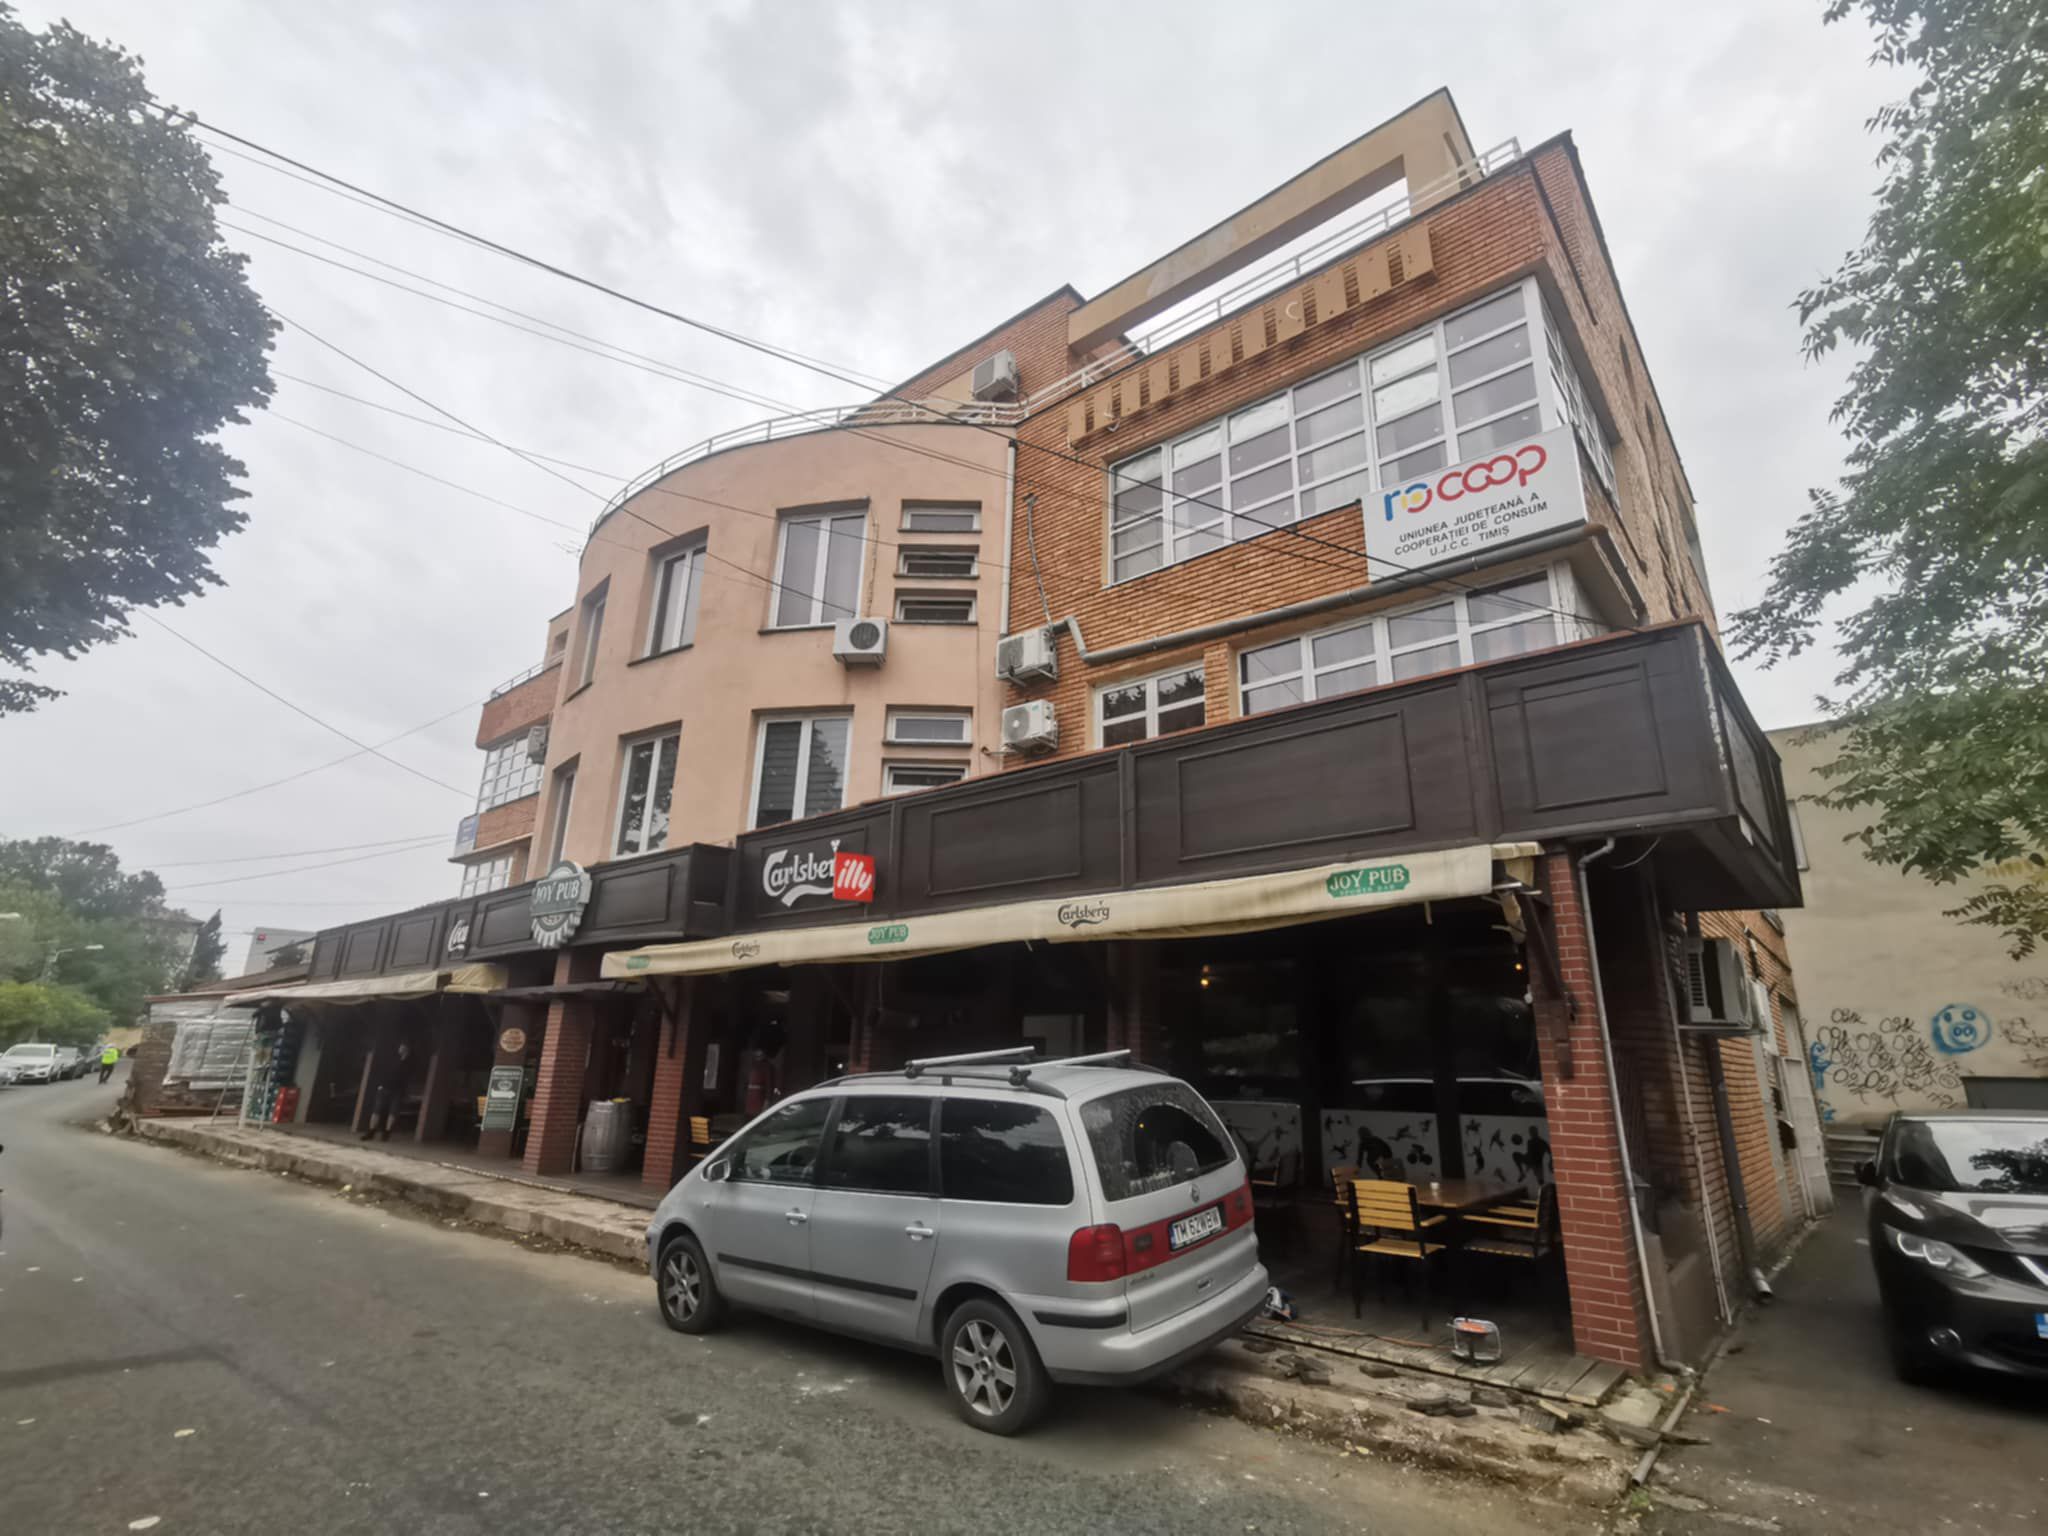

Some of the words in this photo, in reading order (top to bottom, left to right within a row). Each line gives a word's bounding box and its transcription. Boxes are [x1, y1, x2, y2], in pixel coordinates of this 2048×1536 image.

[1394, 528, 1470, 556] COOPERAȚIEI
[1472, 520, 1488, 533] DE
[1494, 501, 1548, 525] CONSUM
[1400, 521, 1448, 543] UNIUNEA
[1530, 492, 1540, 502] A
[1479, 525, 1510, 542] TIMIȘ
[763, 841, 837, 898] Carlsber
[837, 858, 873, 897] illy
[1330, 870, 1363, 890] JOY
[1368, 867, 1405, 887] PUB
[534, 881, 557, 904] JOY
[556, 879, 580, 901] PUB
[1058, 901, 1110, 925] Carlsberg
[888, 926, 907, 939] PUB
